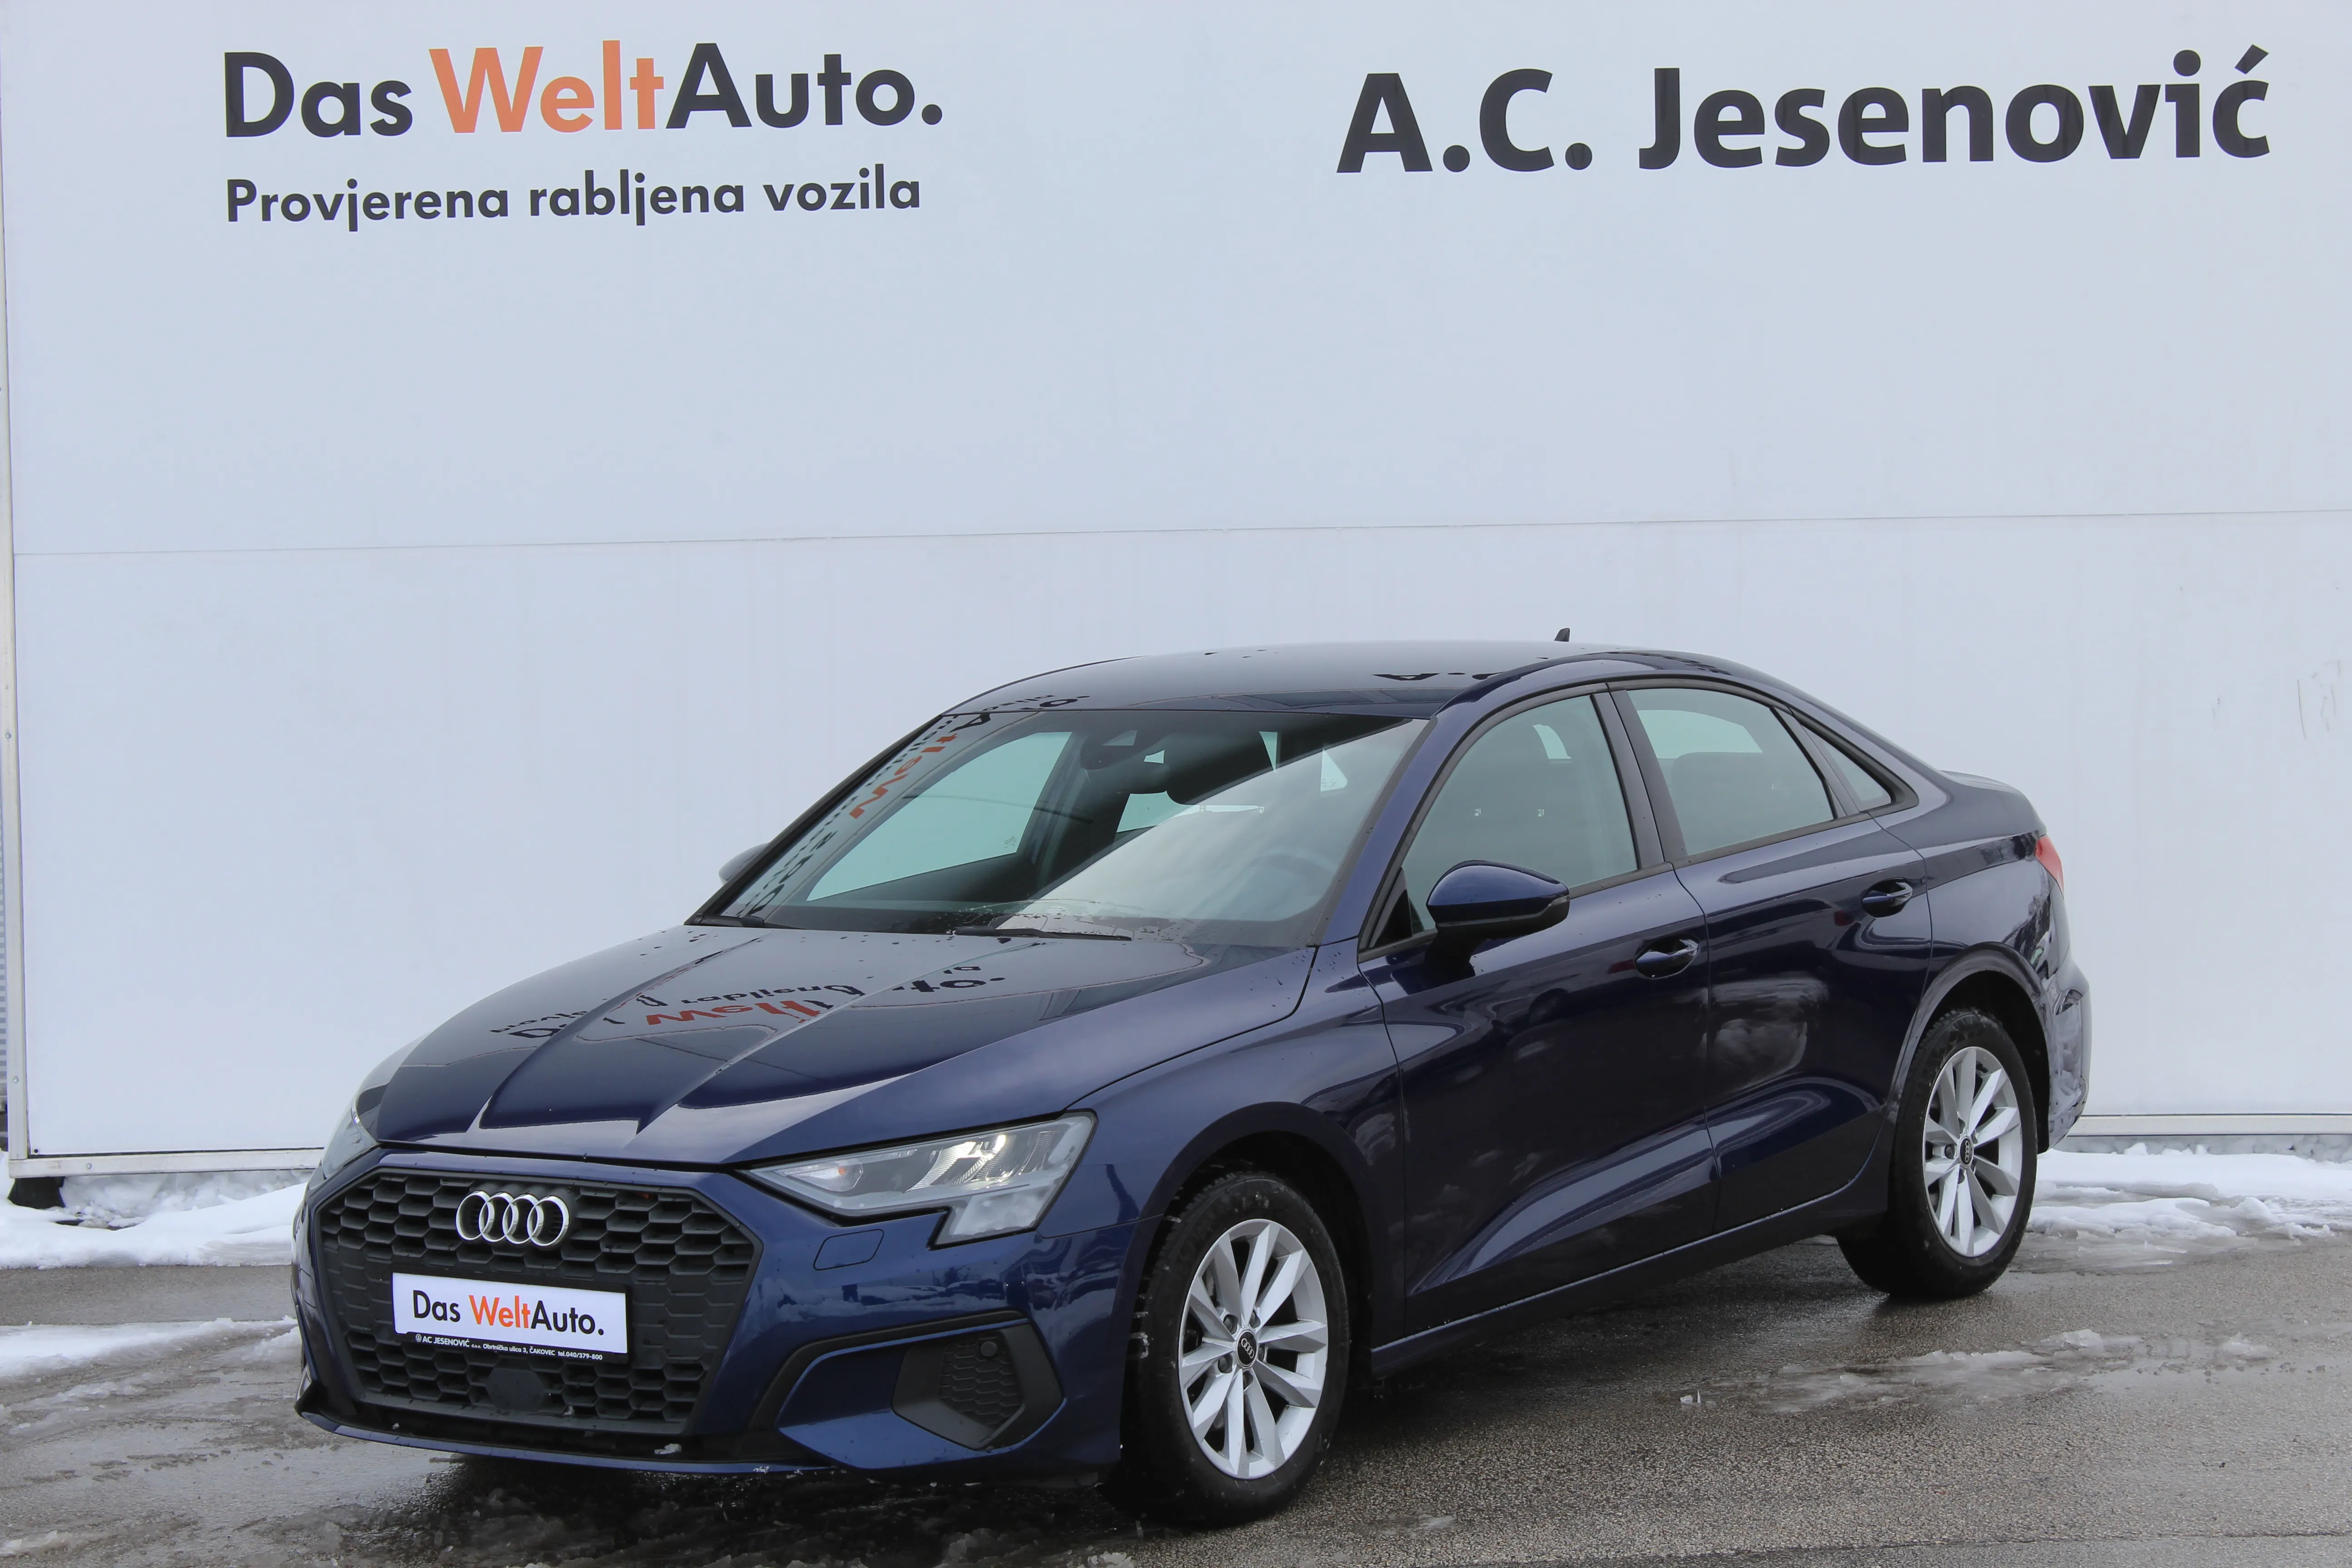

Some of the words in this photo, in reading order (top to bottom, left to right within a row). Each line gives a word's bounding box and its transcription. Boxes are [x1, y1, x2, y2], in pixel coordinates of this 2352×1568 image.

[224, 52, 413, 138] Das
[429, 40, 942, 133] WeltAuto.
[1336, 69, 1592, 173] A.C.
[1639, 44, 2270, 170] Jesenović
[227, 178, 508, 232] Provjerena
[530, 169, 744, 226] rabljena
[763, 163, 920, 211] vozila
[412, 1289, 461, 1322] Das
[468, 1295, 604, 1336] WeltAuto.
[433, 1337, 470, 1347] JESENOVIĆ
[529, 1346, 555, 1356] ČAKOVEC
